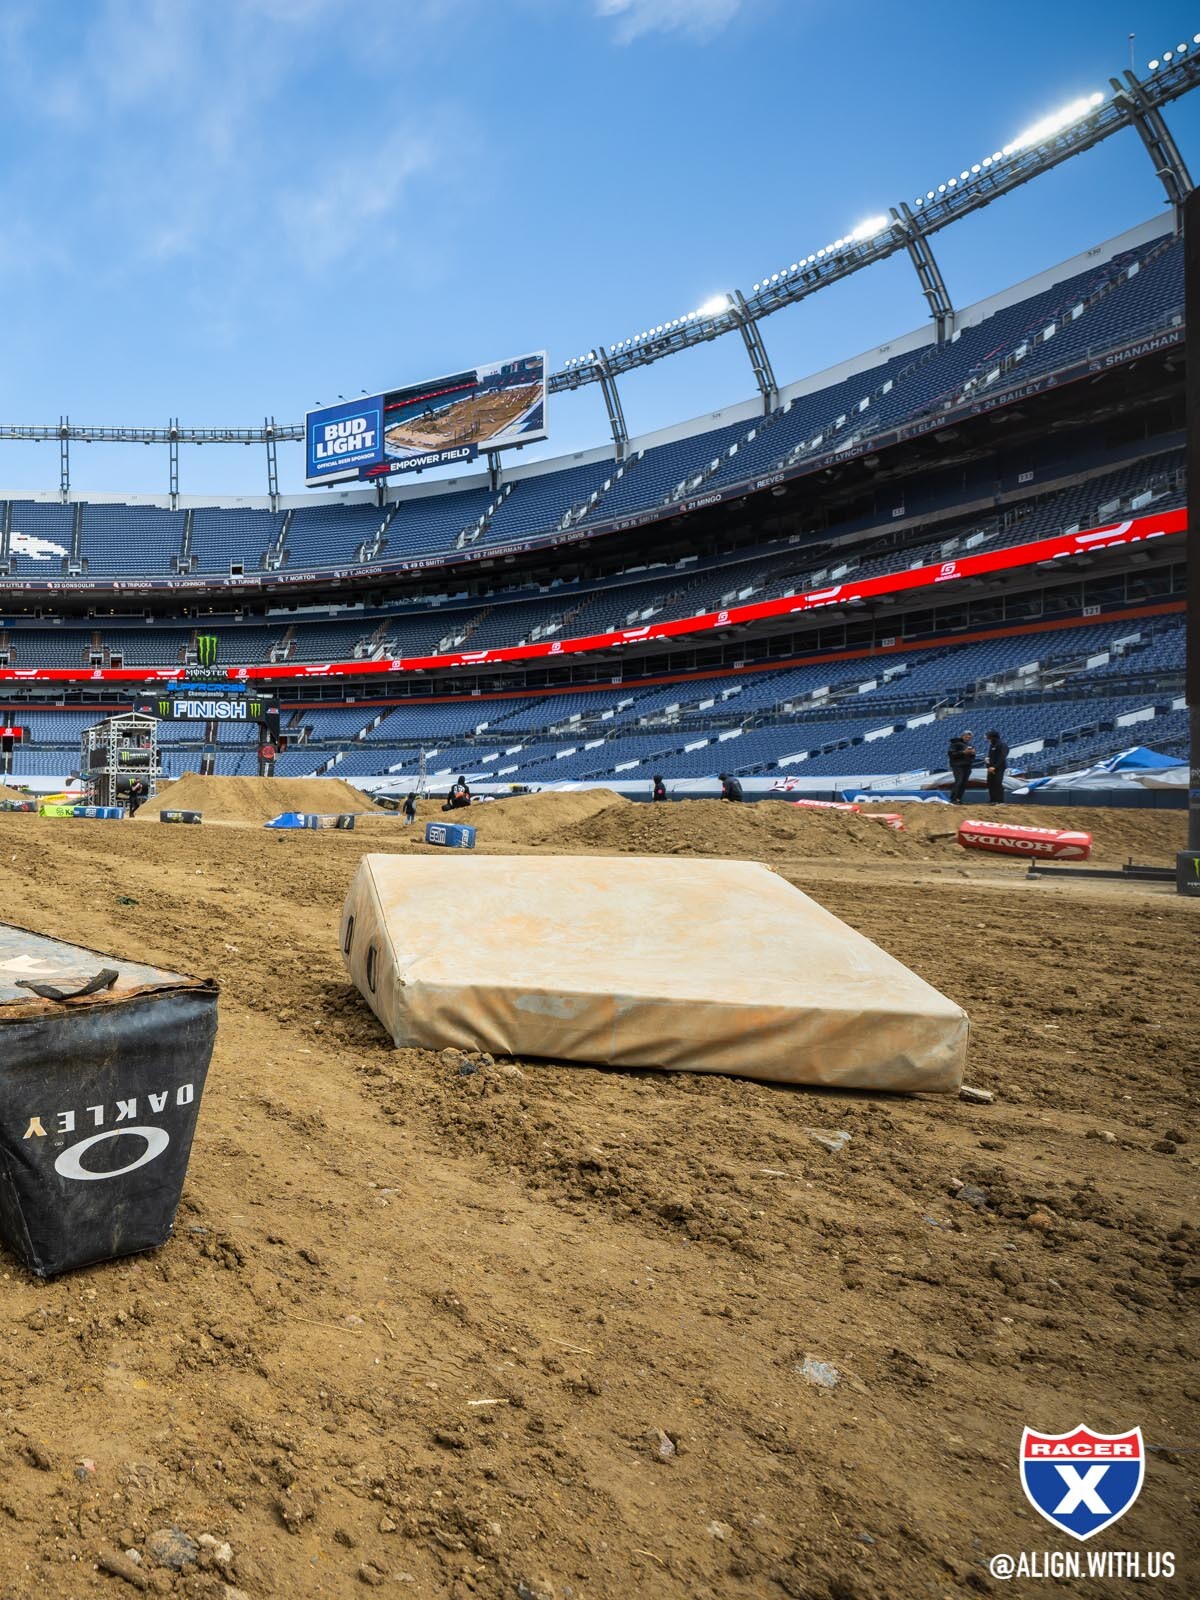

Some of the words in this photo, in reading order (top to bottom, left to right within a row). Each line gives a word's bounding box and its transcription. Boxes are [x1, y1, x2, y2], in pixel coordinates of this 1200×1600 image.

[1105, 333, 1179, 366] SHANAHAN
[985, 400, 996, 409] 24
[1000, 383, 1041, 403] BAILEY
[325, 418, 367, 441] BUD
[918, 417, 946, 433] ELAM
[316, 431, 376, 459] LIGHT
[390, 453, 440, 471] EMPOWER
[441, 447, 470, 460] FIELD
[835, 446, 864, 462] LYNCH
[756, 473, 785, 489] REEVES
[697, 494, 722, 507] MINGO
[567, 532, 585, 541] DAVIS
[482, 546, 522, 557] ZIMMERMAN
[426, 559, 445, 567] SMITH
[355, 567, 382, 576] JACKSON
[1084, 606, 1100, 616] 121
[185, 669, 228, 677] MONSTER
[173, 700, 246, 719] FINISH
[961, 833, 1055, 852] HONDA
[22, 1083, 194, 1140] OAKLEY
